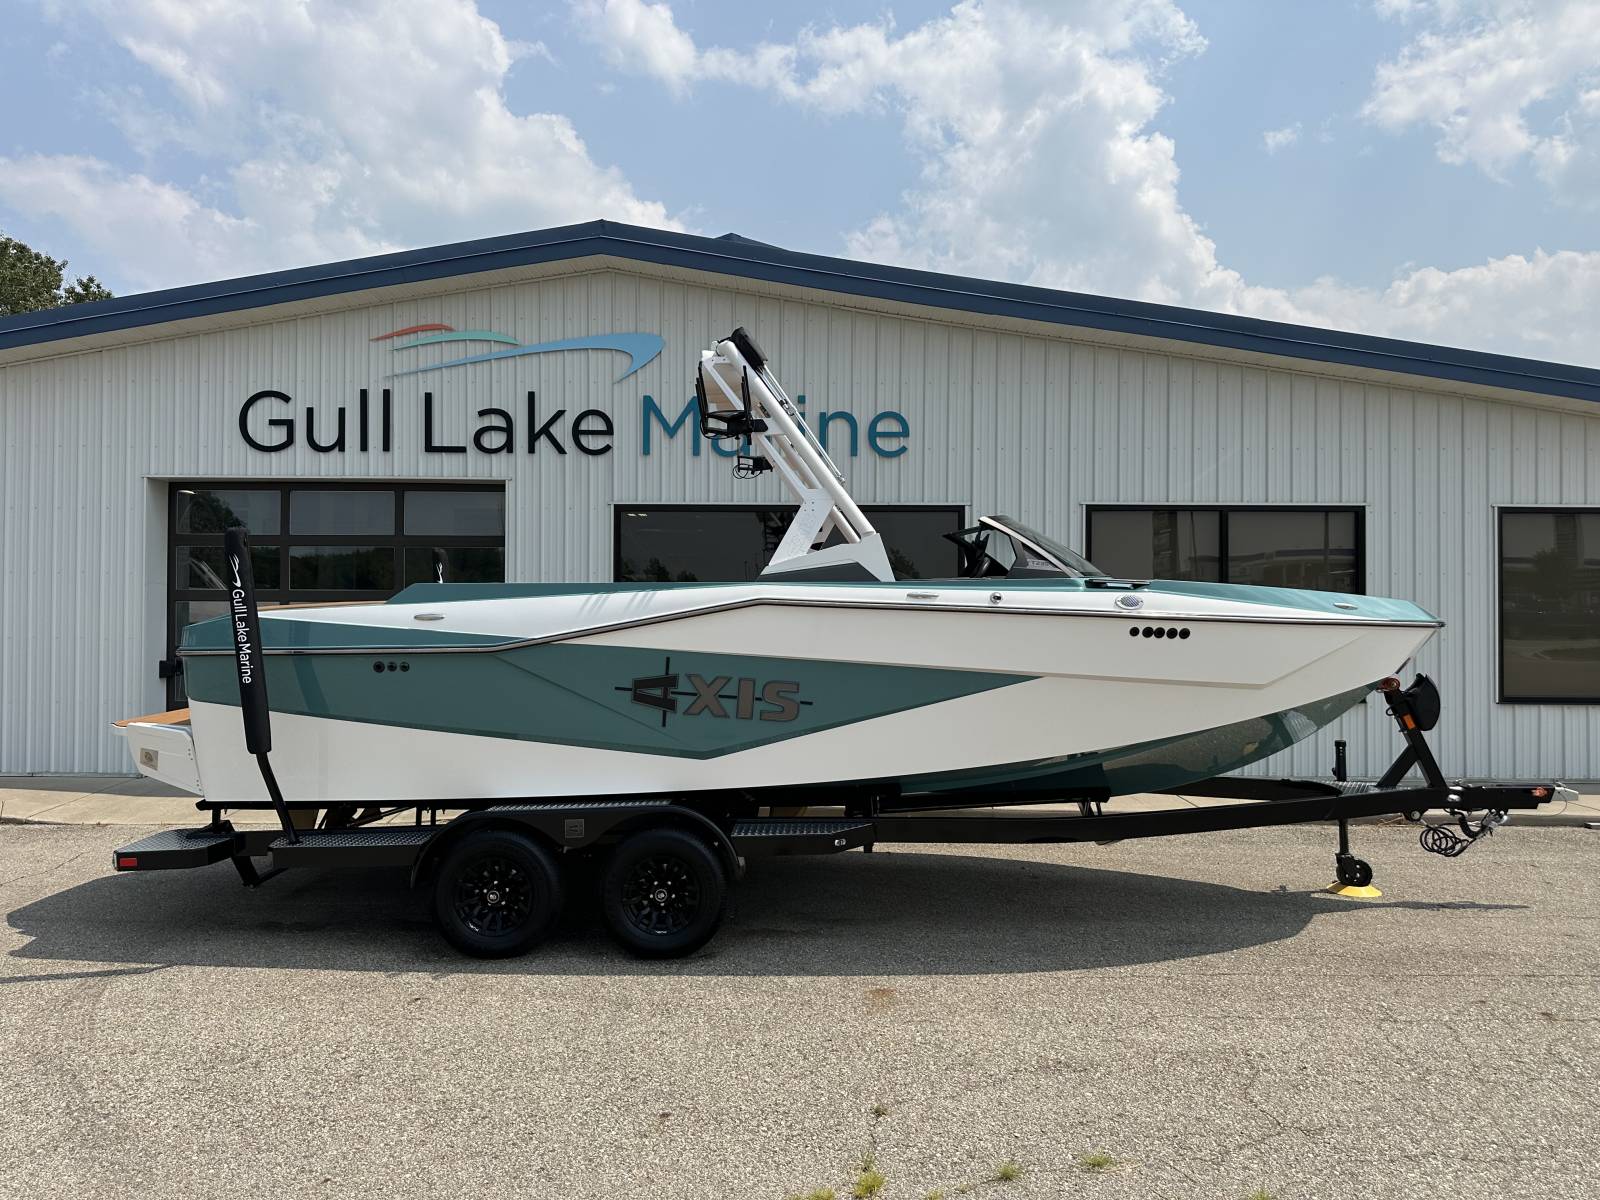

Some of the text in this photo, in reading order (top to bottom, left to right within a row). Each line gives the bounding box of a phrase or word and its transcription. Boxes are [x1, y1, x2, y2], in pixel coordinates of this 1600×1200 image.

[238, 388, 910, 458] Gull Lake Mine
[232, 589, 254, 684] Gull Lake Marine
[631, 673, 800, 722] AXIS
